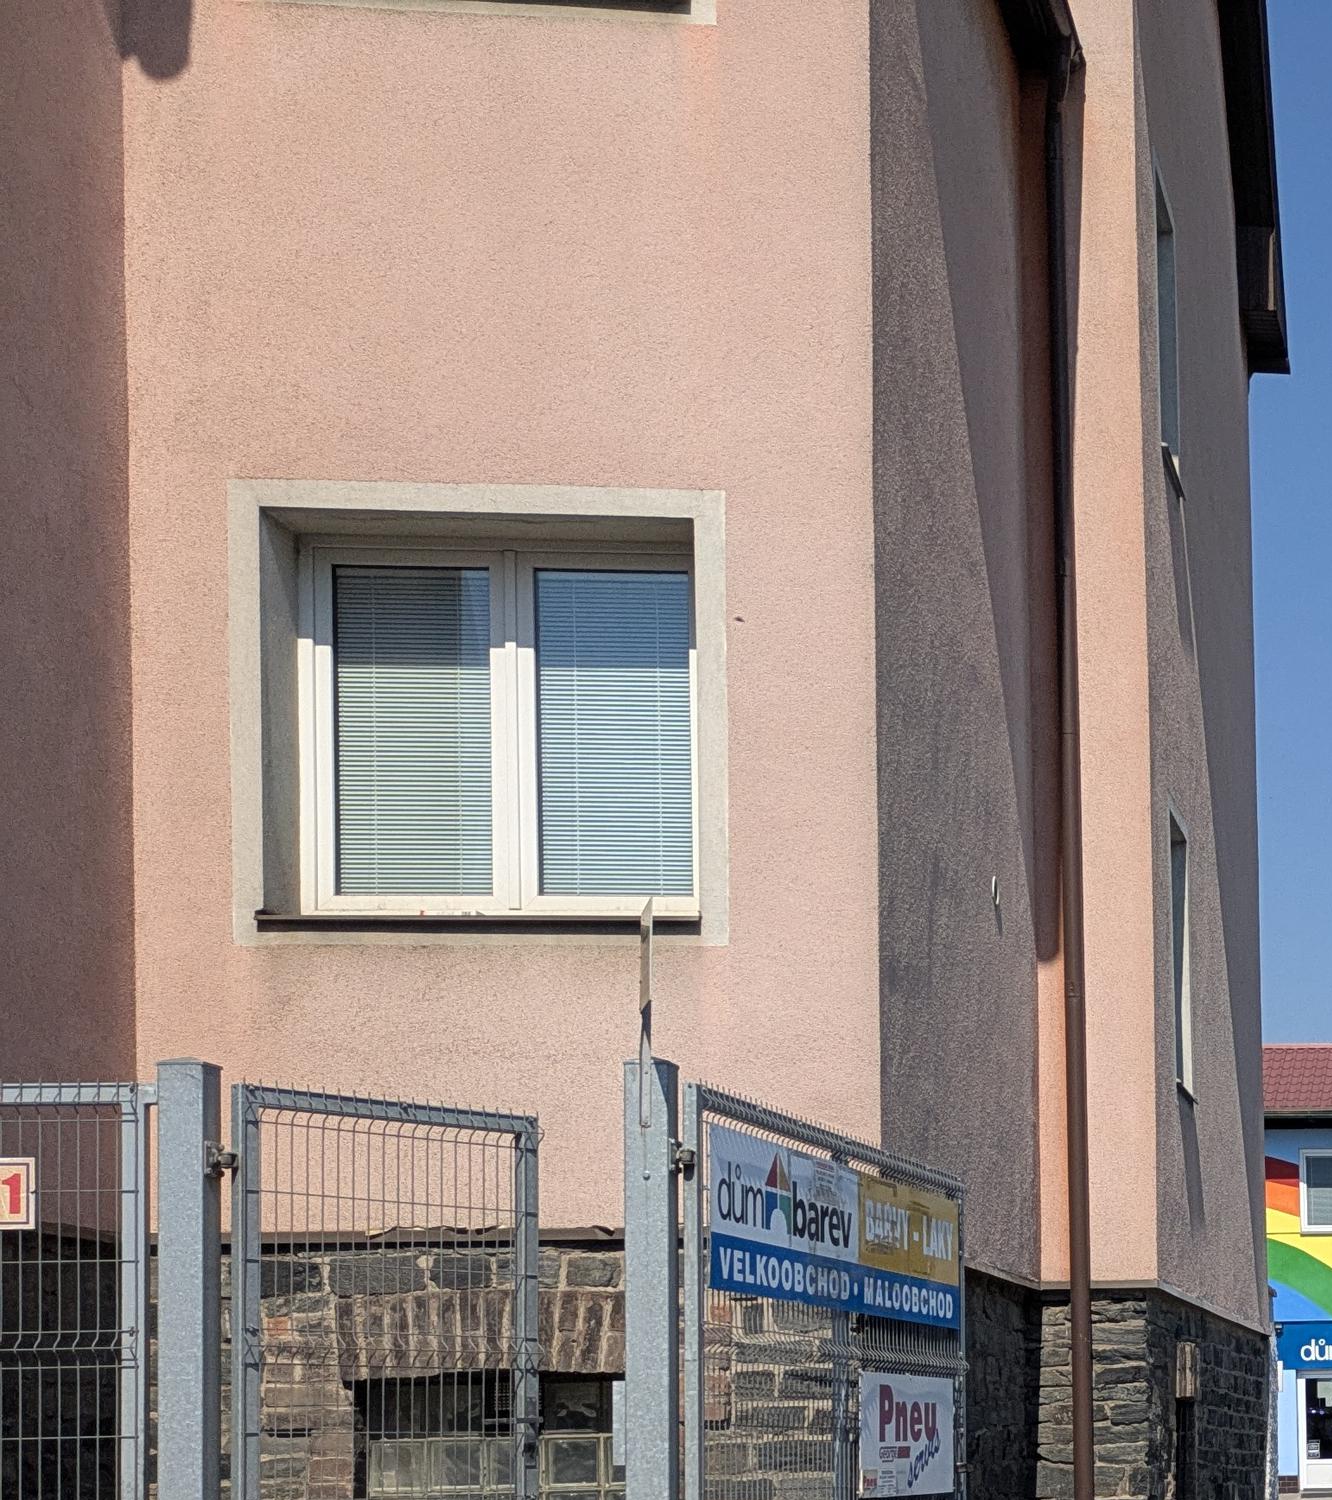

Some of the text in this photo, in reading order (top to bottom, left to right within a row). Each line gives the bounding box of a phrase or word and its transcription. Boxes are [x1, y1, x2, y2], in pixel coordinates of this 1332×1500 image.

[717, 1160, 853, 1249] dům barev
[922, 1215, 953, 1261] LAKY
[719, 1246, 954, 1319] VELKOOBCHOD MALOOBCHOD
[879, 1384, 937, 1443] Pneu
